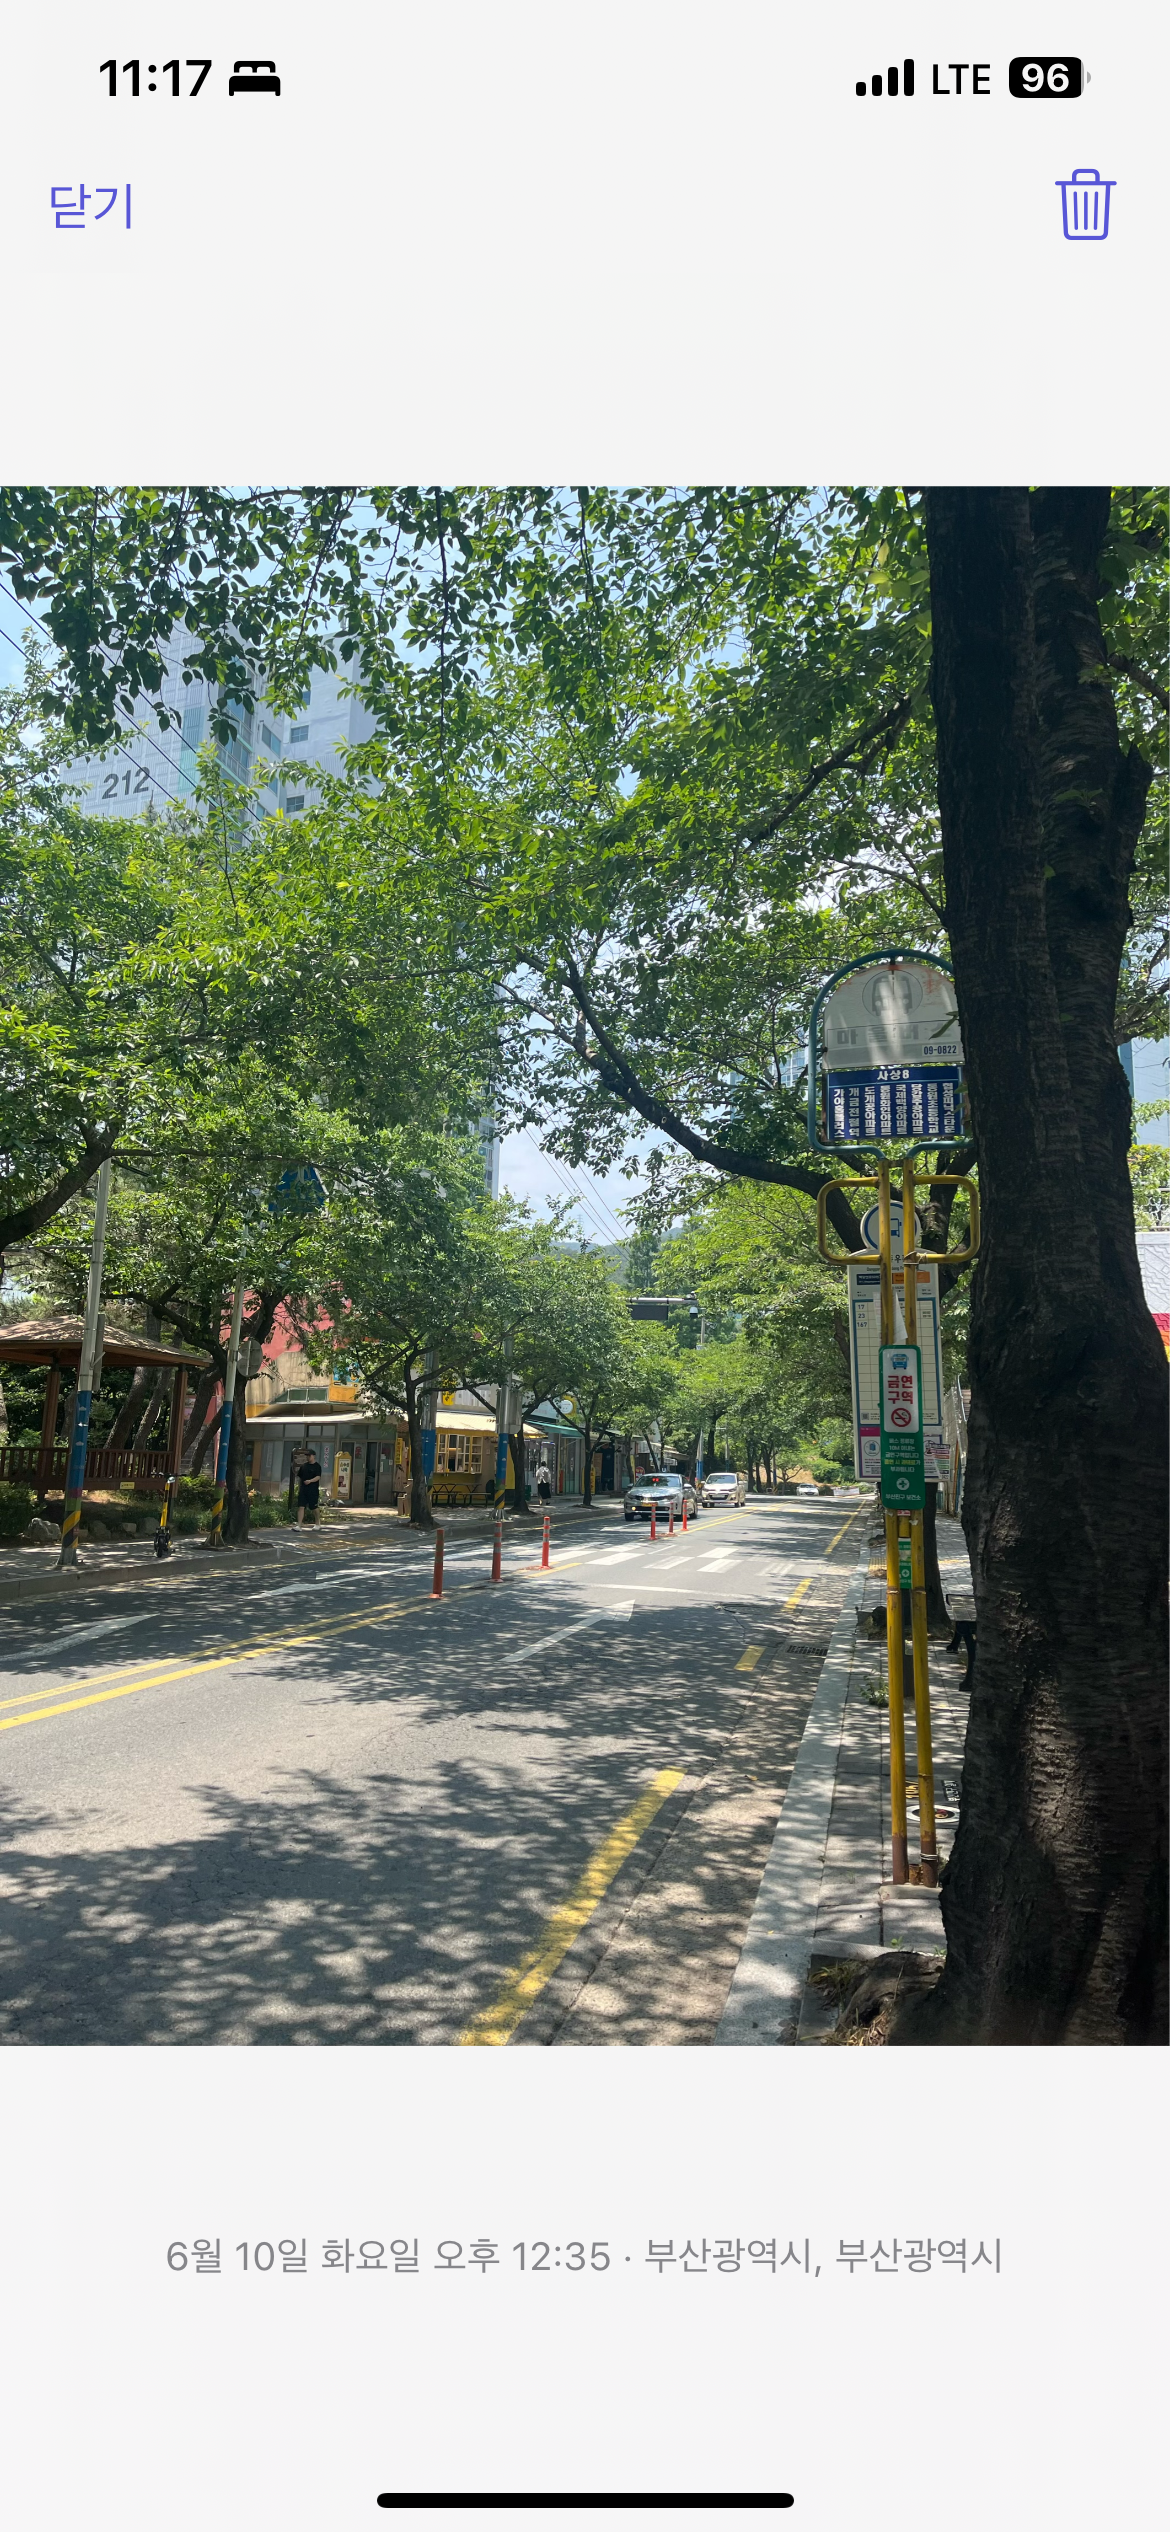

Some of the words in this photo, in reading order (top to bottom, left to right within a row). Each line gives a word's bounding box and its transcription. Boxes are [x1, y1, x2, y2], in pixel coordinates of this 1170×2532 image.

[101, 766, 150, 799] 212
[923, 1045, 957, 1055] 09-0822
[877, 1070, 910, 1081] 사상8
[848, 1087, 860, 1137] 개금전철역
[864, 1086, 876, 1136] 도개공아파트
[927, 1082, 939, 1134] 동원초등학교
[887, 1375, 914, 1389] 금연
[887, 1391, 914, 1405] 구역
